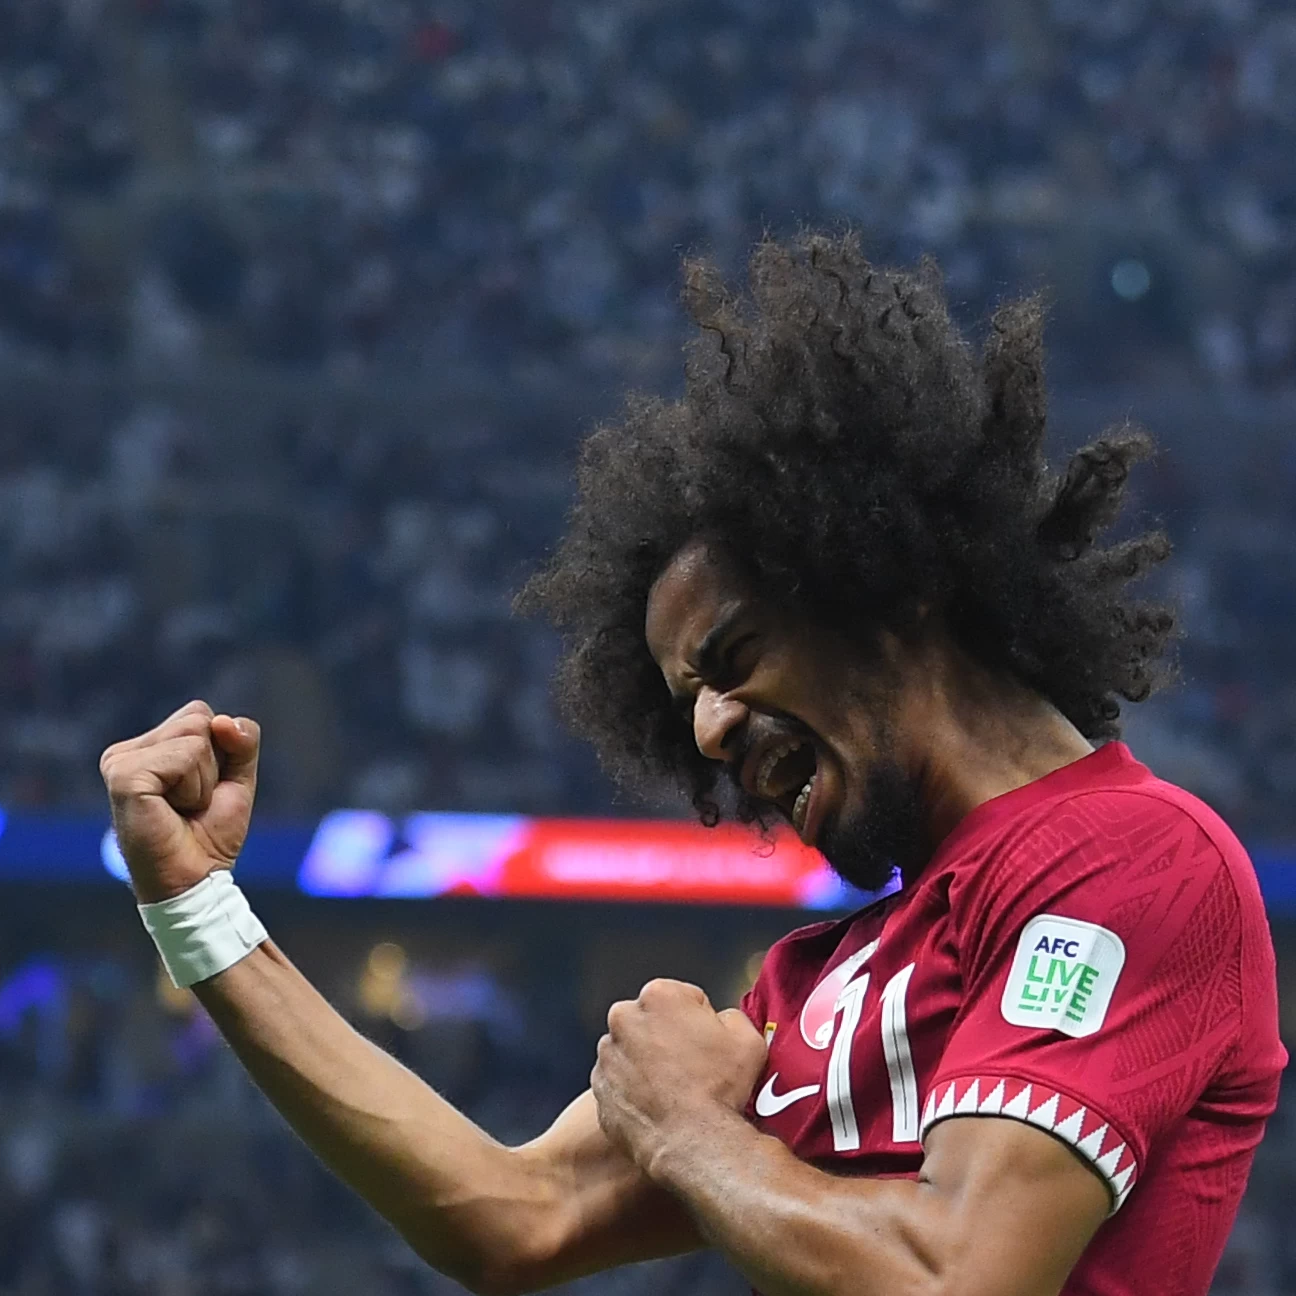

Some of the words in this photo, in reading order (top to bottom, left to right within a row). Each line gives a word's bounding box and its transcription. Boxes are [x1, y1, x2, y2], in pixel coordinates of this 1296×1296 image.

[1034, 935, 1080, 958] AFC
[1026, 955, 1100, 996] LIVE
[826, 962, 919, 1152] 11
